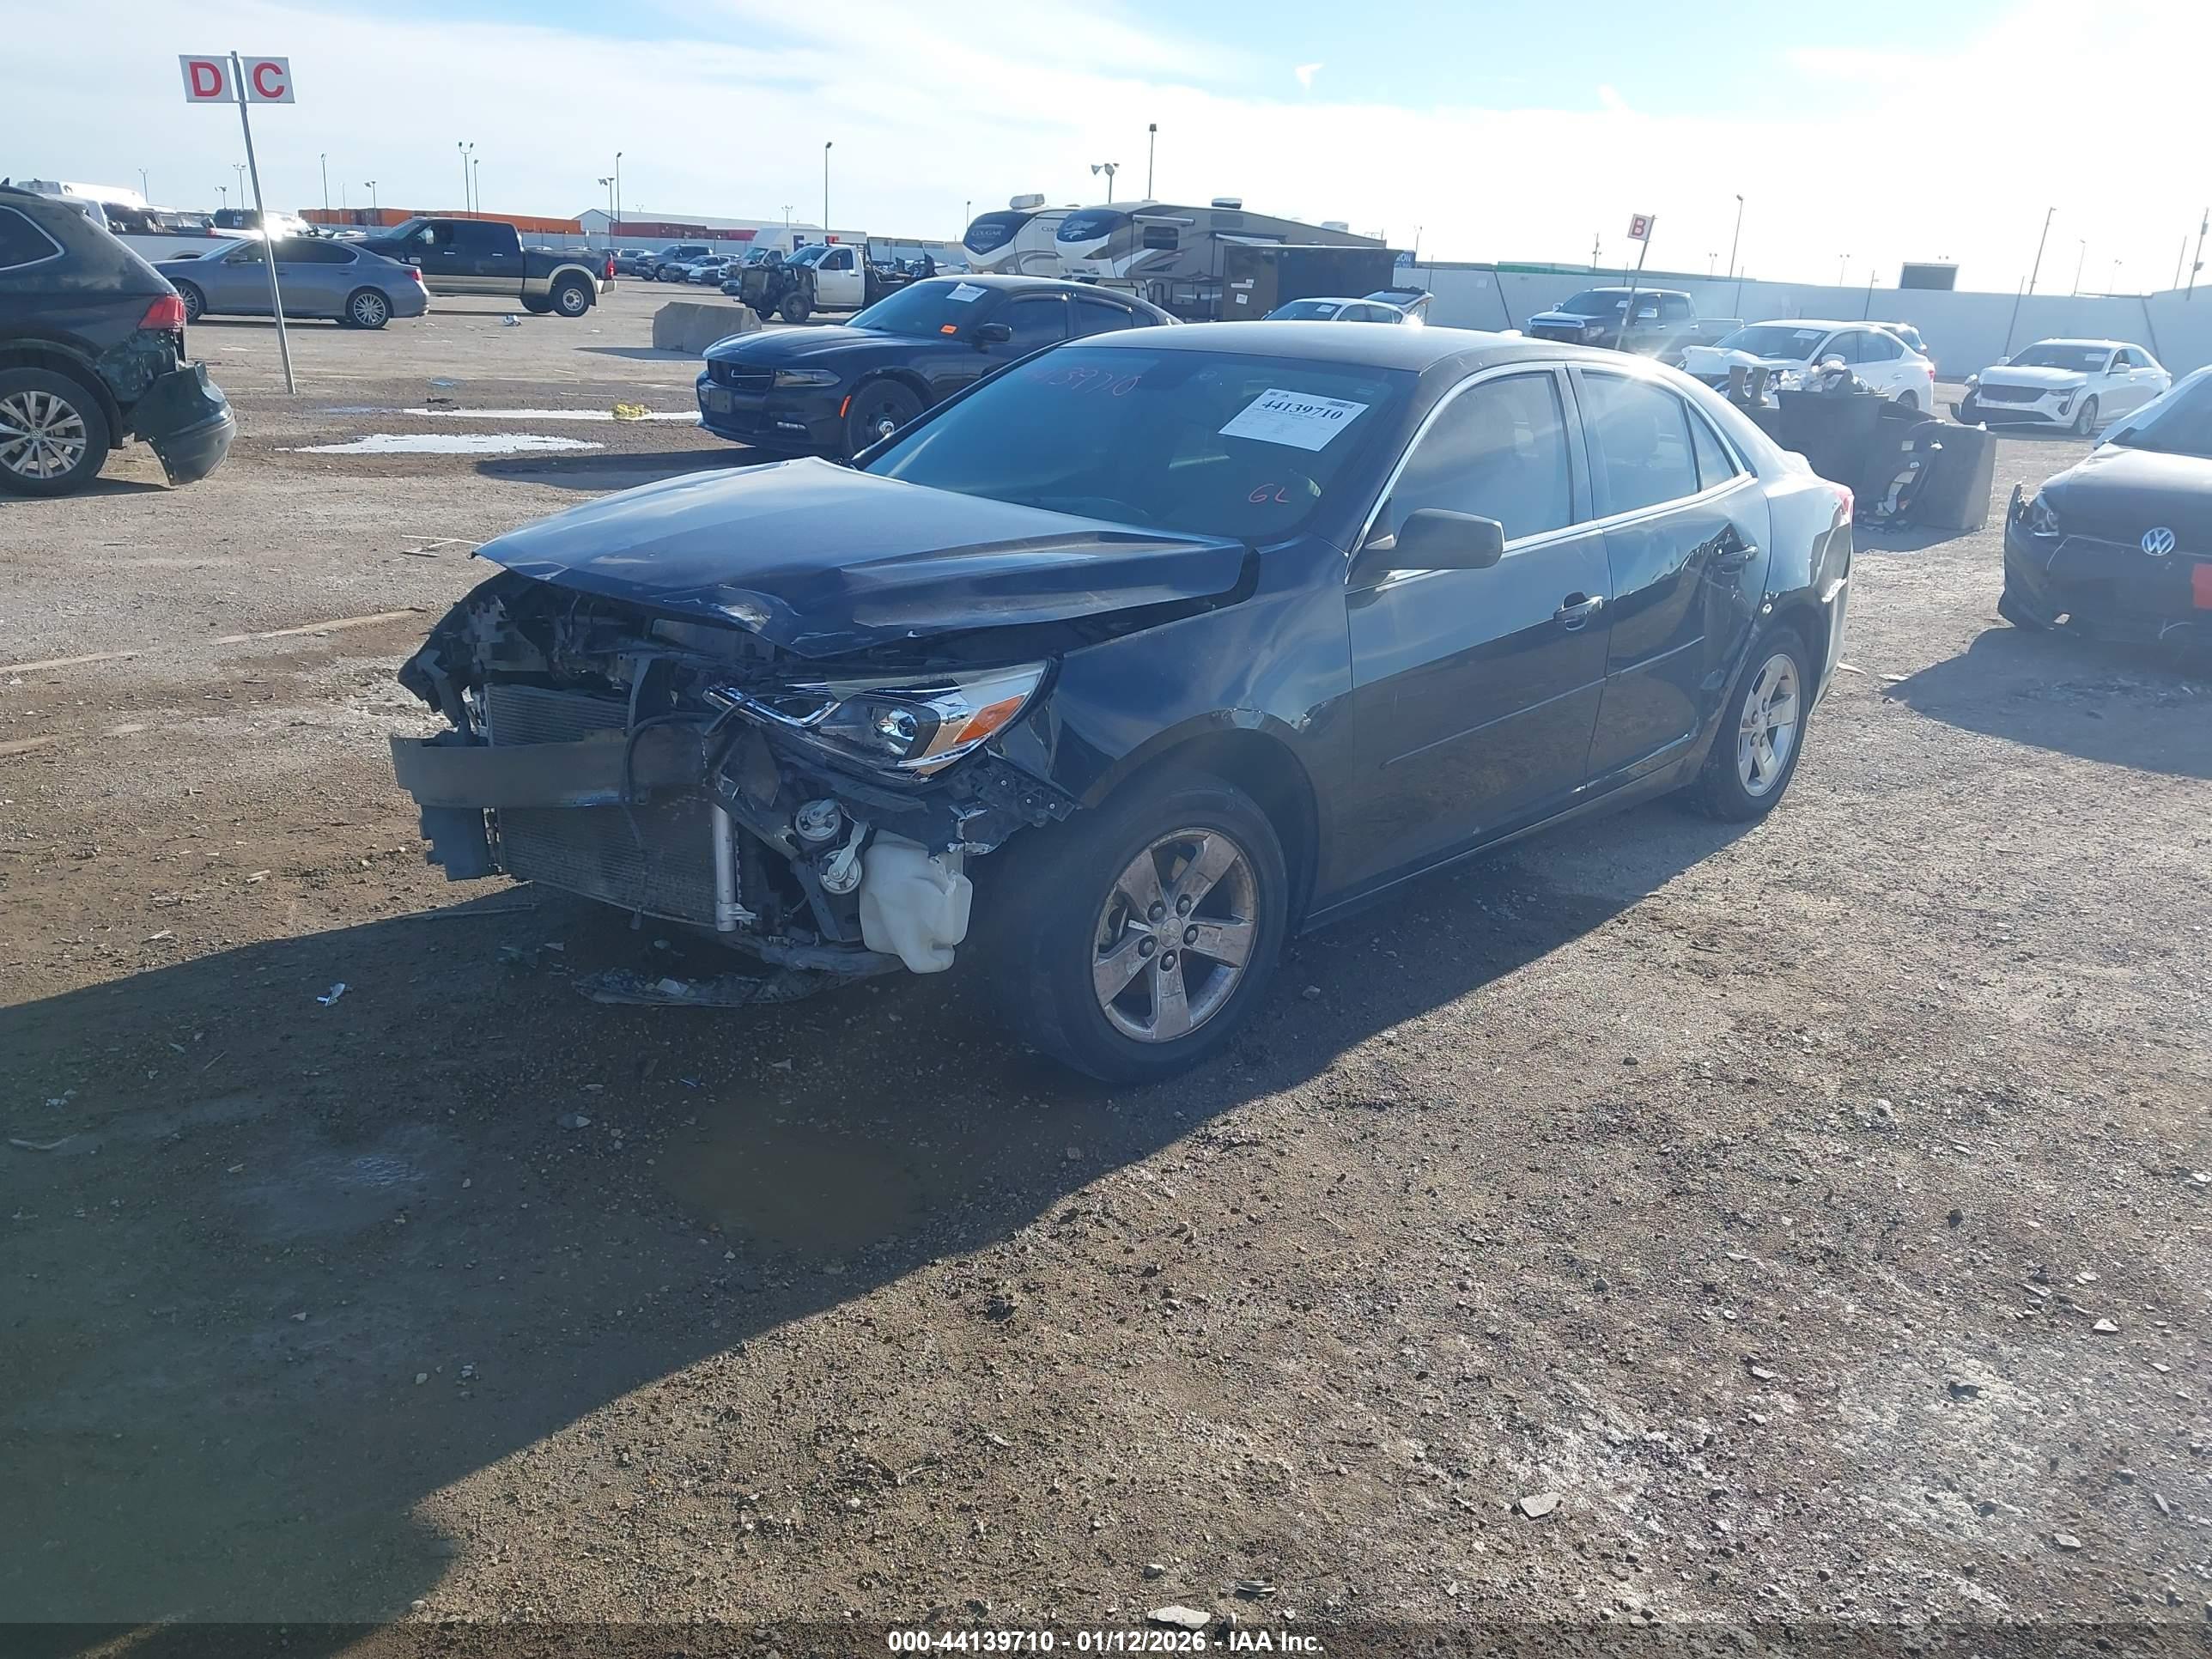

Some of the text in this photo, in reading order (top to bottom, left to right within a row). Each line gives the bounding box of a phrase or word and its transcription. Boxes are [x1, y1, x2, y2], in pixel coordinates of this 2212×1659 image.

[188, 61, 222, 97] D
[252, 62, 285, 98] C
[1632, 216, 1646, 236] B
[1261, 399, 1344, 420] 44139710
